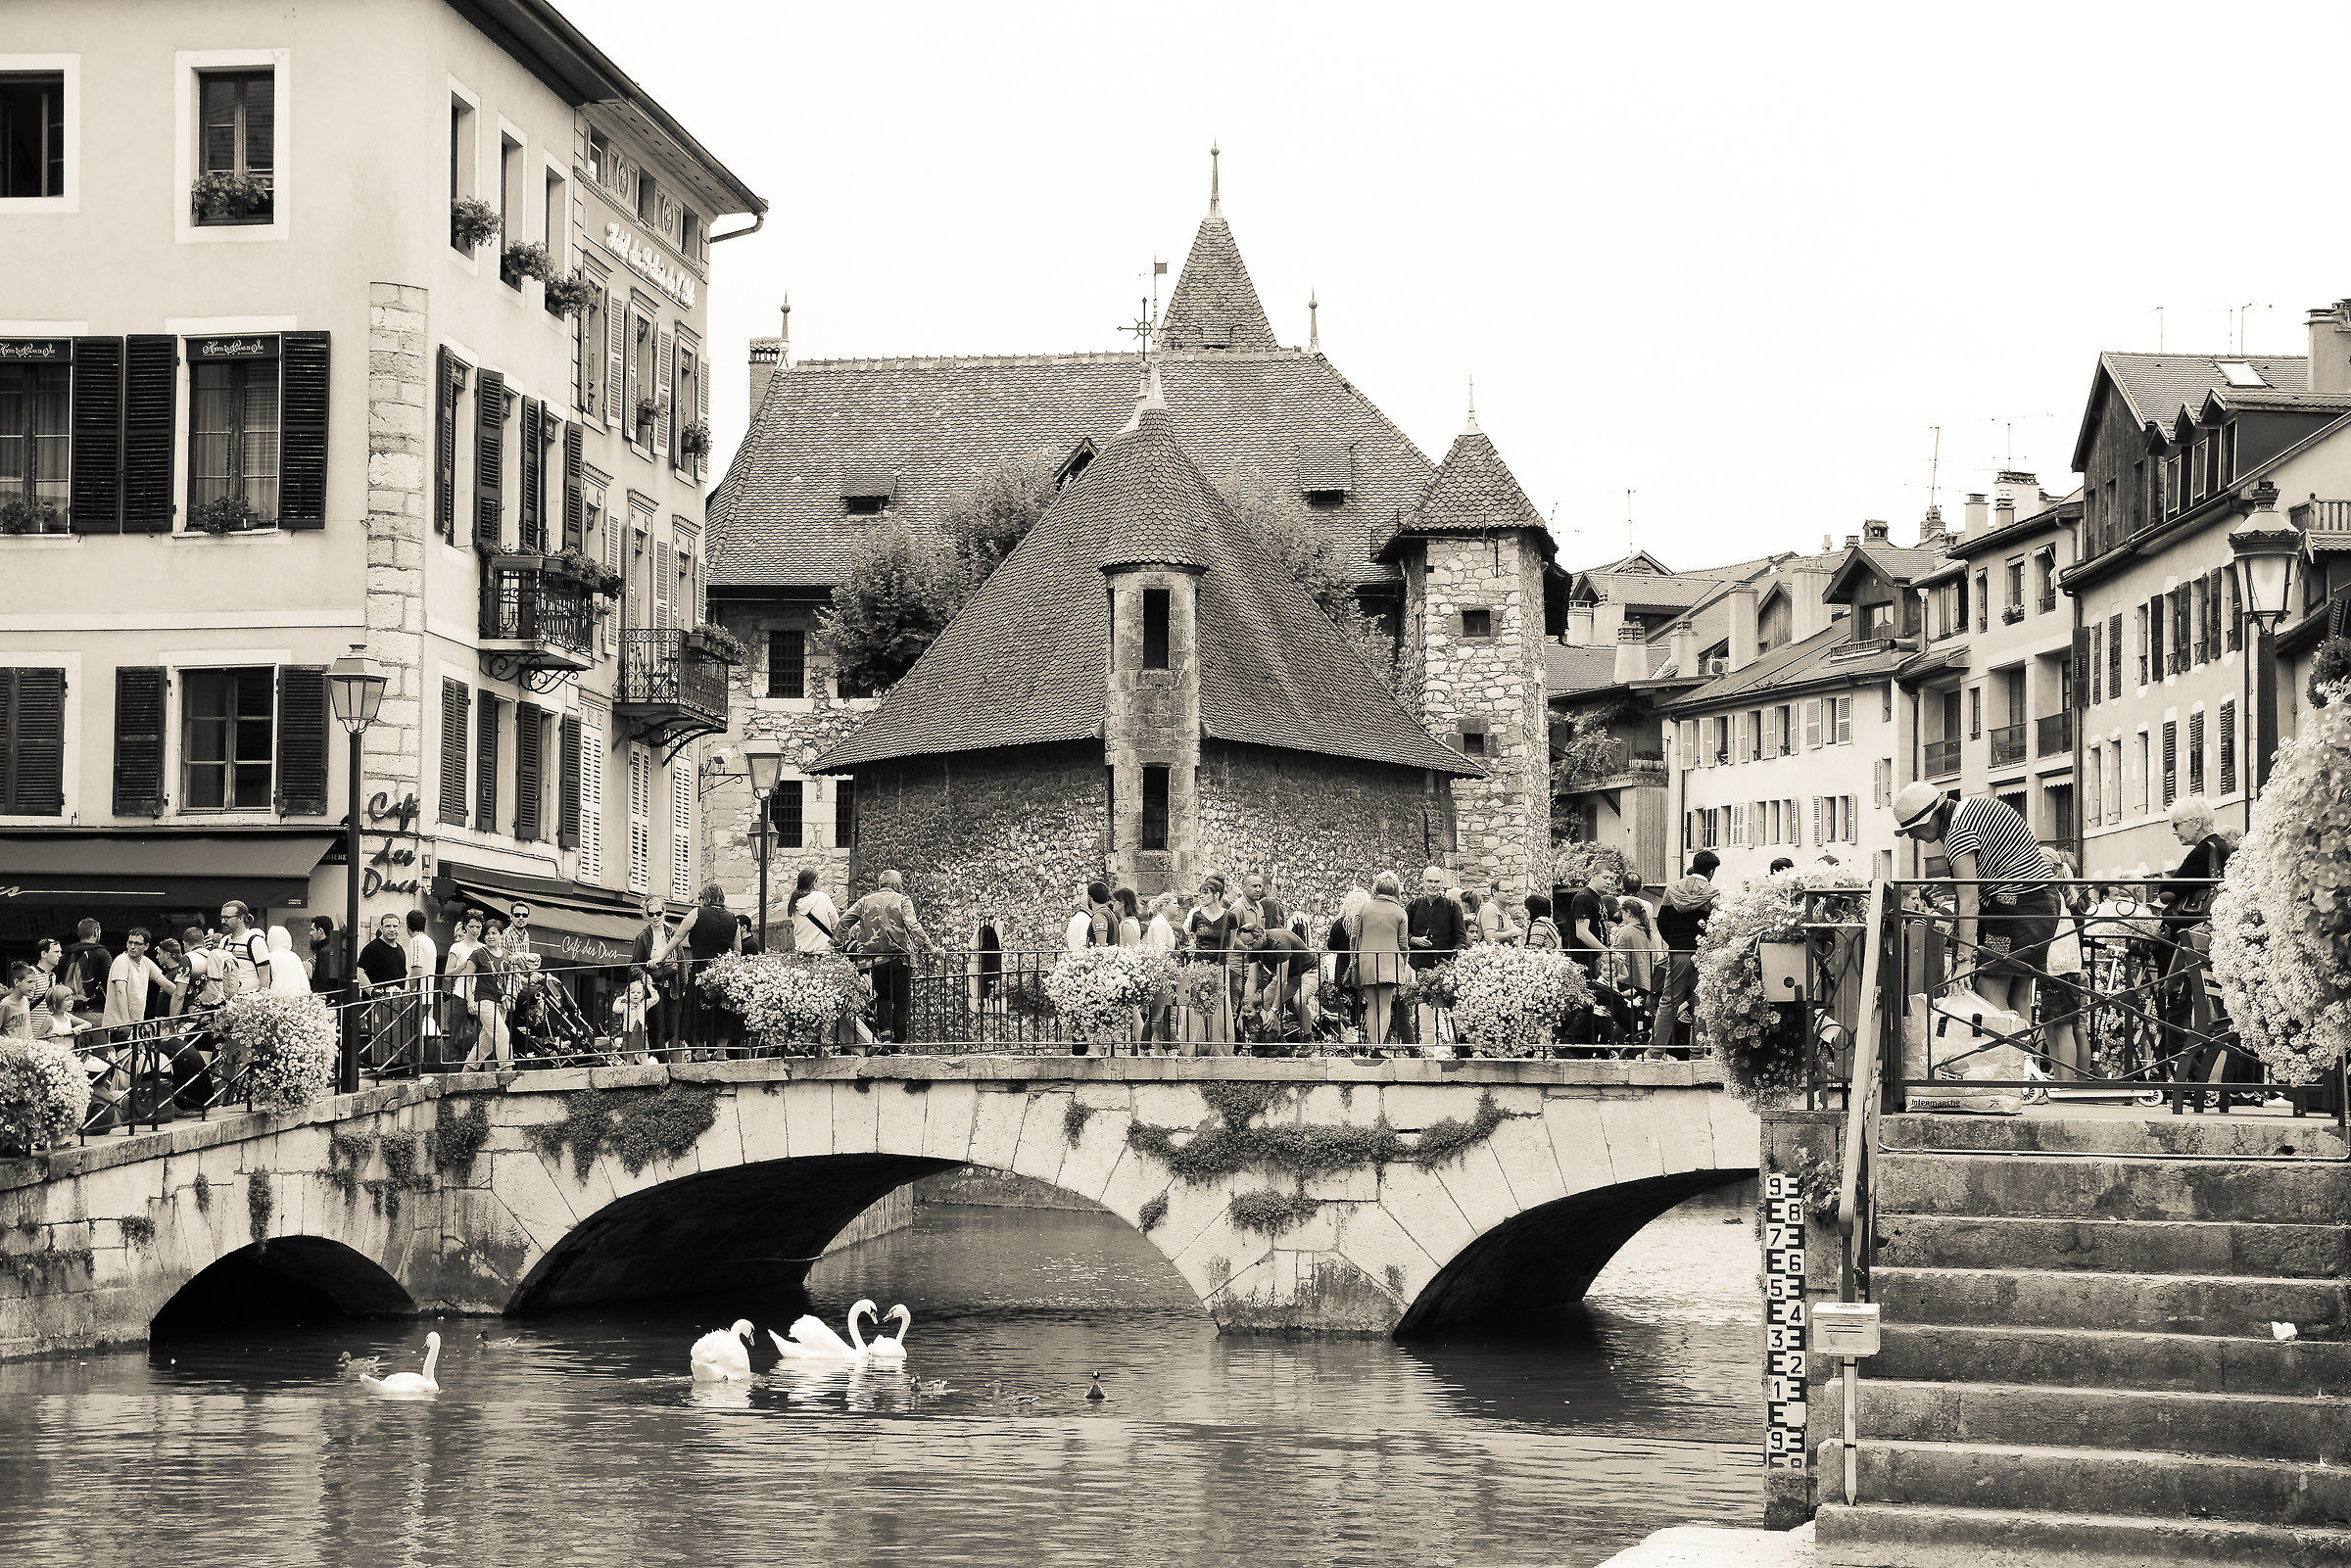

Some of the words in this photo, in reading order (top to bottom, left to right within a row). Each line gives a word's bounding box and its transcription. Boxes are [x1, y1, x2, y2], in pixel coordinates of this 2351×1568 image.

[367, 791, 420, 831] Café
[370, 837, 416, 867] des
[562, 935, 582, 960] Café
[581, 938, 598, 957] des
[599, 940, 619, 959] Ducs
[1769, 1177, 1782, 1196] 9
[1788, 1203, 1801, 1222] 8
[1769, 1228, 1782, 1247] 7
[1789, 1254, 1801, 1272] 6
[1770, 1279, 1783, 1298] 5
[1790, 1305, 1802, 1323] 4
[1770, 1329, 1784, 1348] 3
[1790, 1355, 1802, 1374] 2
[1773, 1380, 1781, 1400] 1
[1770, 1431, 1783, 1449] 9
